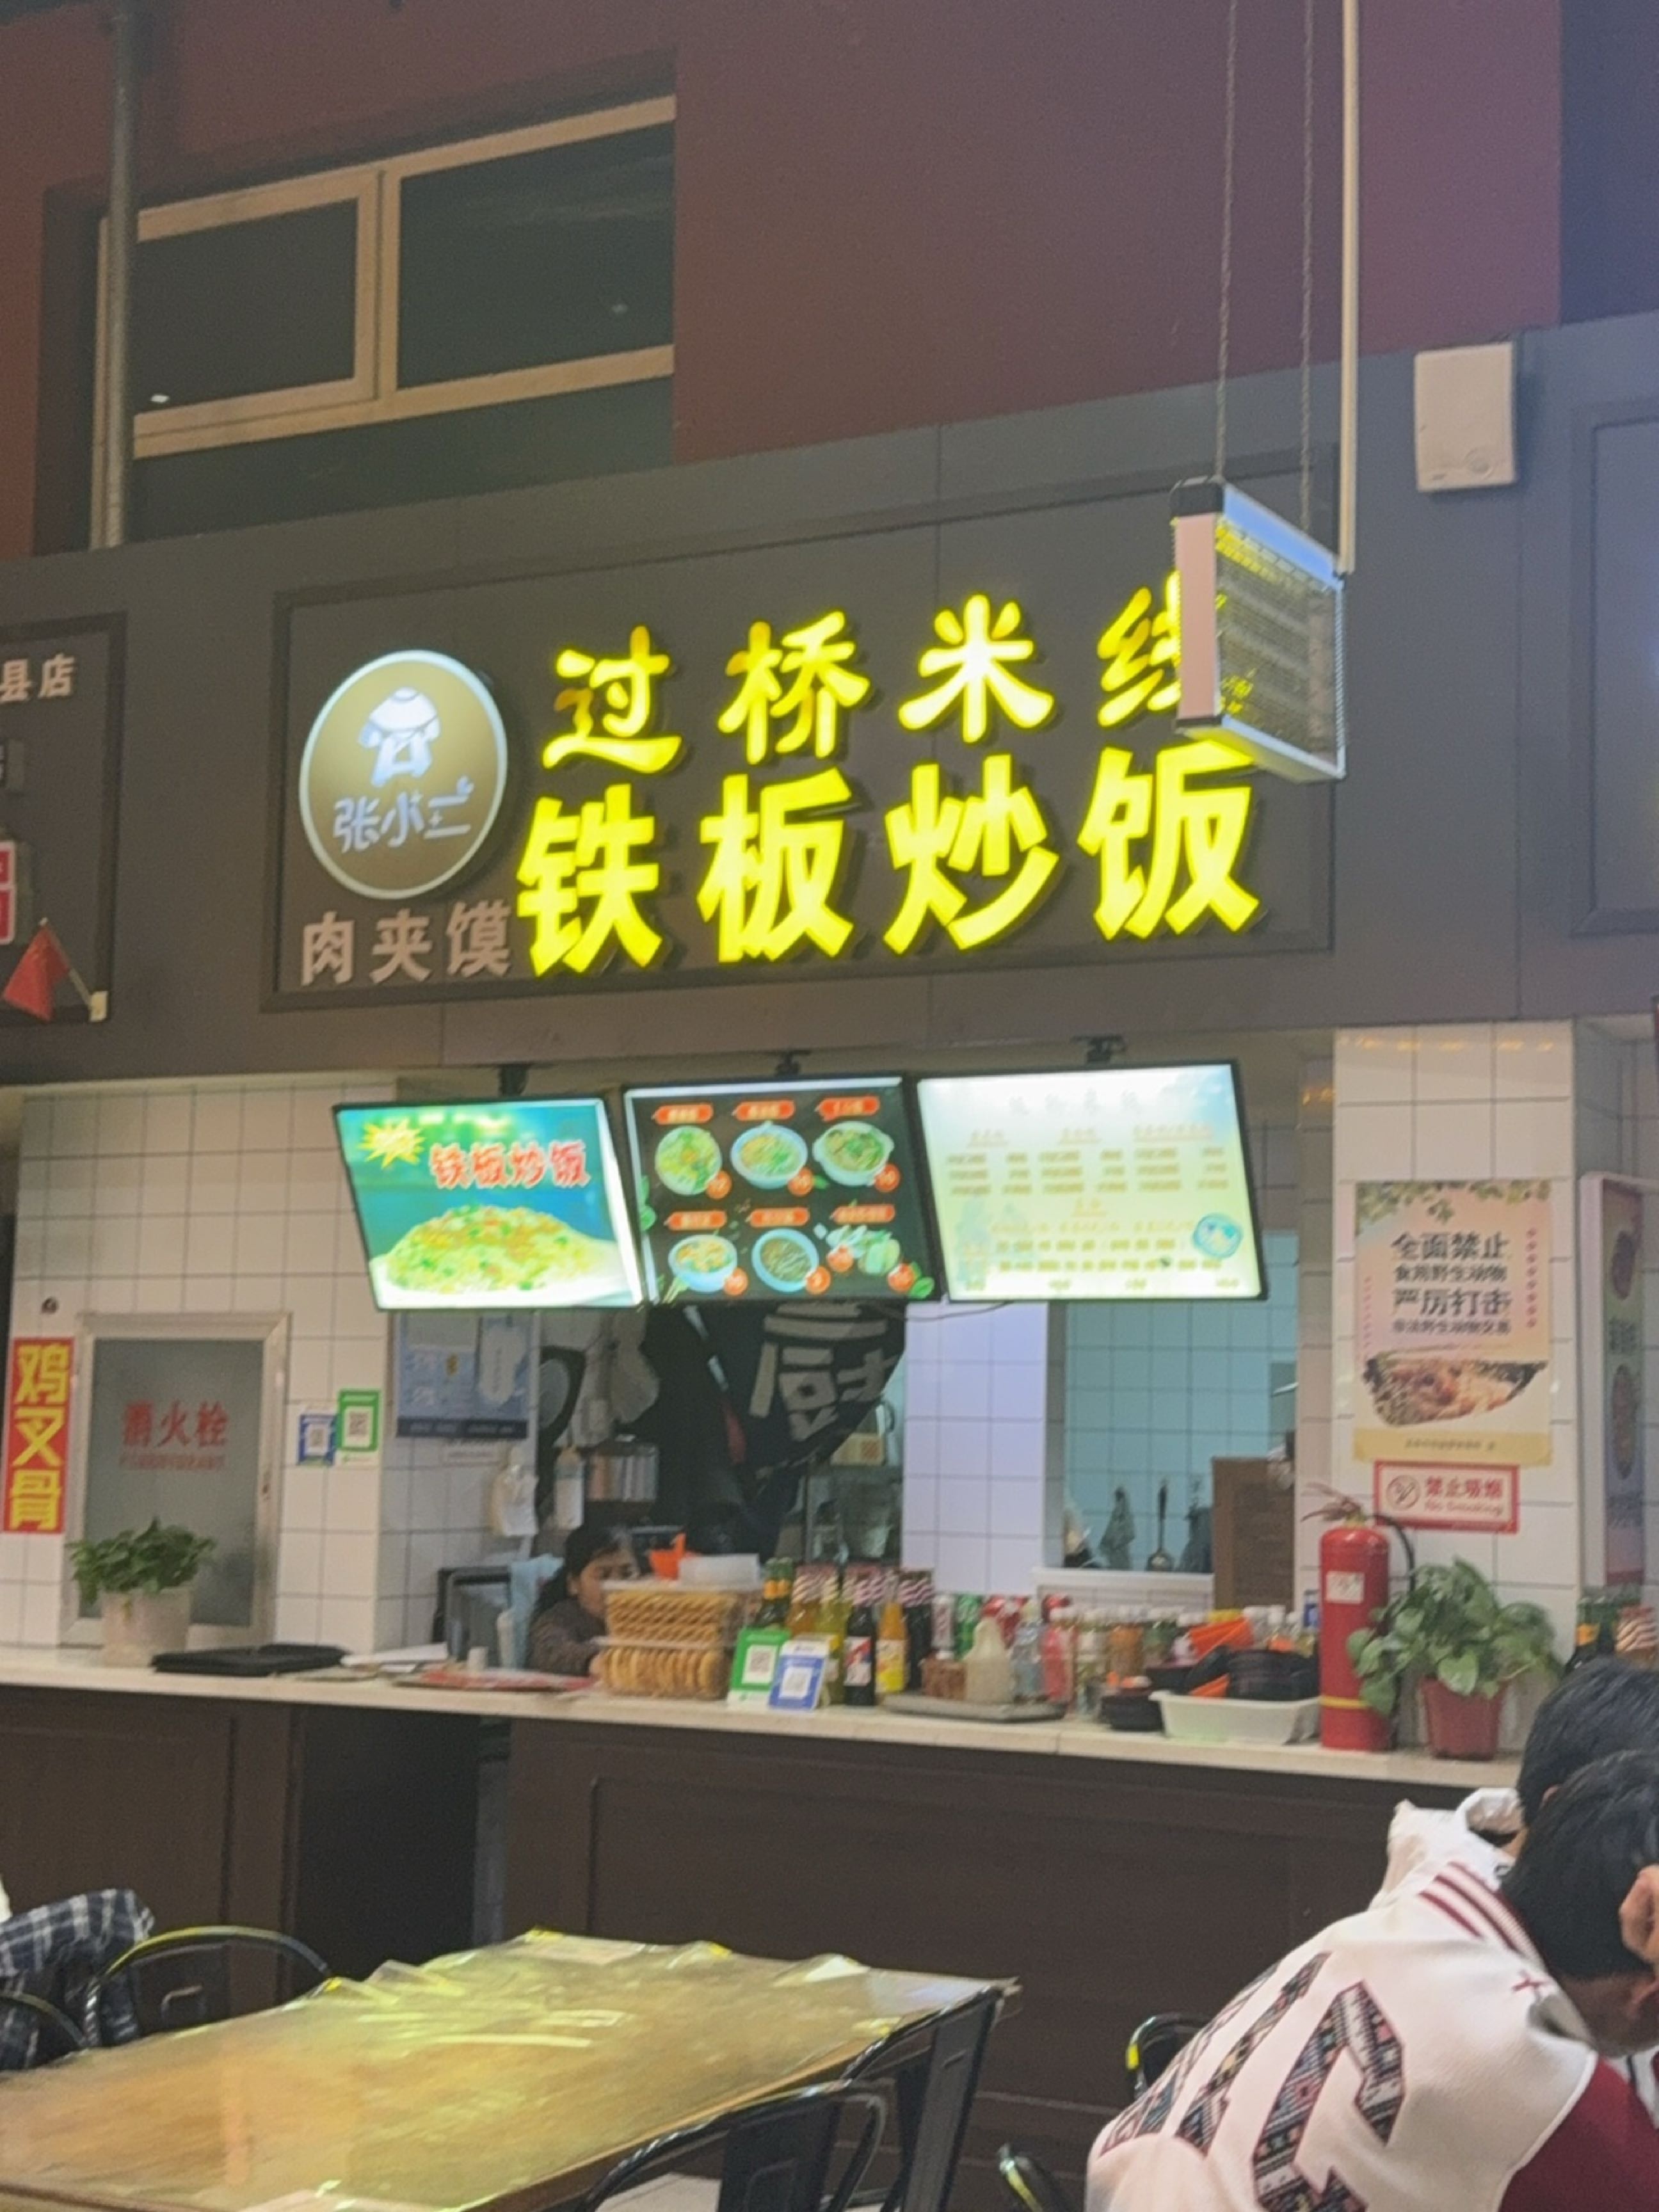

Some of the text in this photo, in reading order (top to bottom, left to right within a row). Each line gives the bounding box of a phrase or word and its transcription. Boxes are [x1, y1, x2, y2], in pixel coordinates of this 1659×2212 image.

[542, 570, 1182, 774] 过桥米线
[332, 776, 474, 854] 张小二
[516, 740, 1261, 978] 铁板炒饭
[300, 899, 512, 986] 肉夹馍
[429, 1139, 591, 1189] 铁板炒饭
[1391, 1230, 1511, 1260] 全面禁止
[1391, 1286, 1512, 1317] 严厉打击
[10, 1344, 70, 1531] 鸡叉骨
